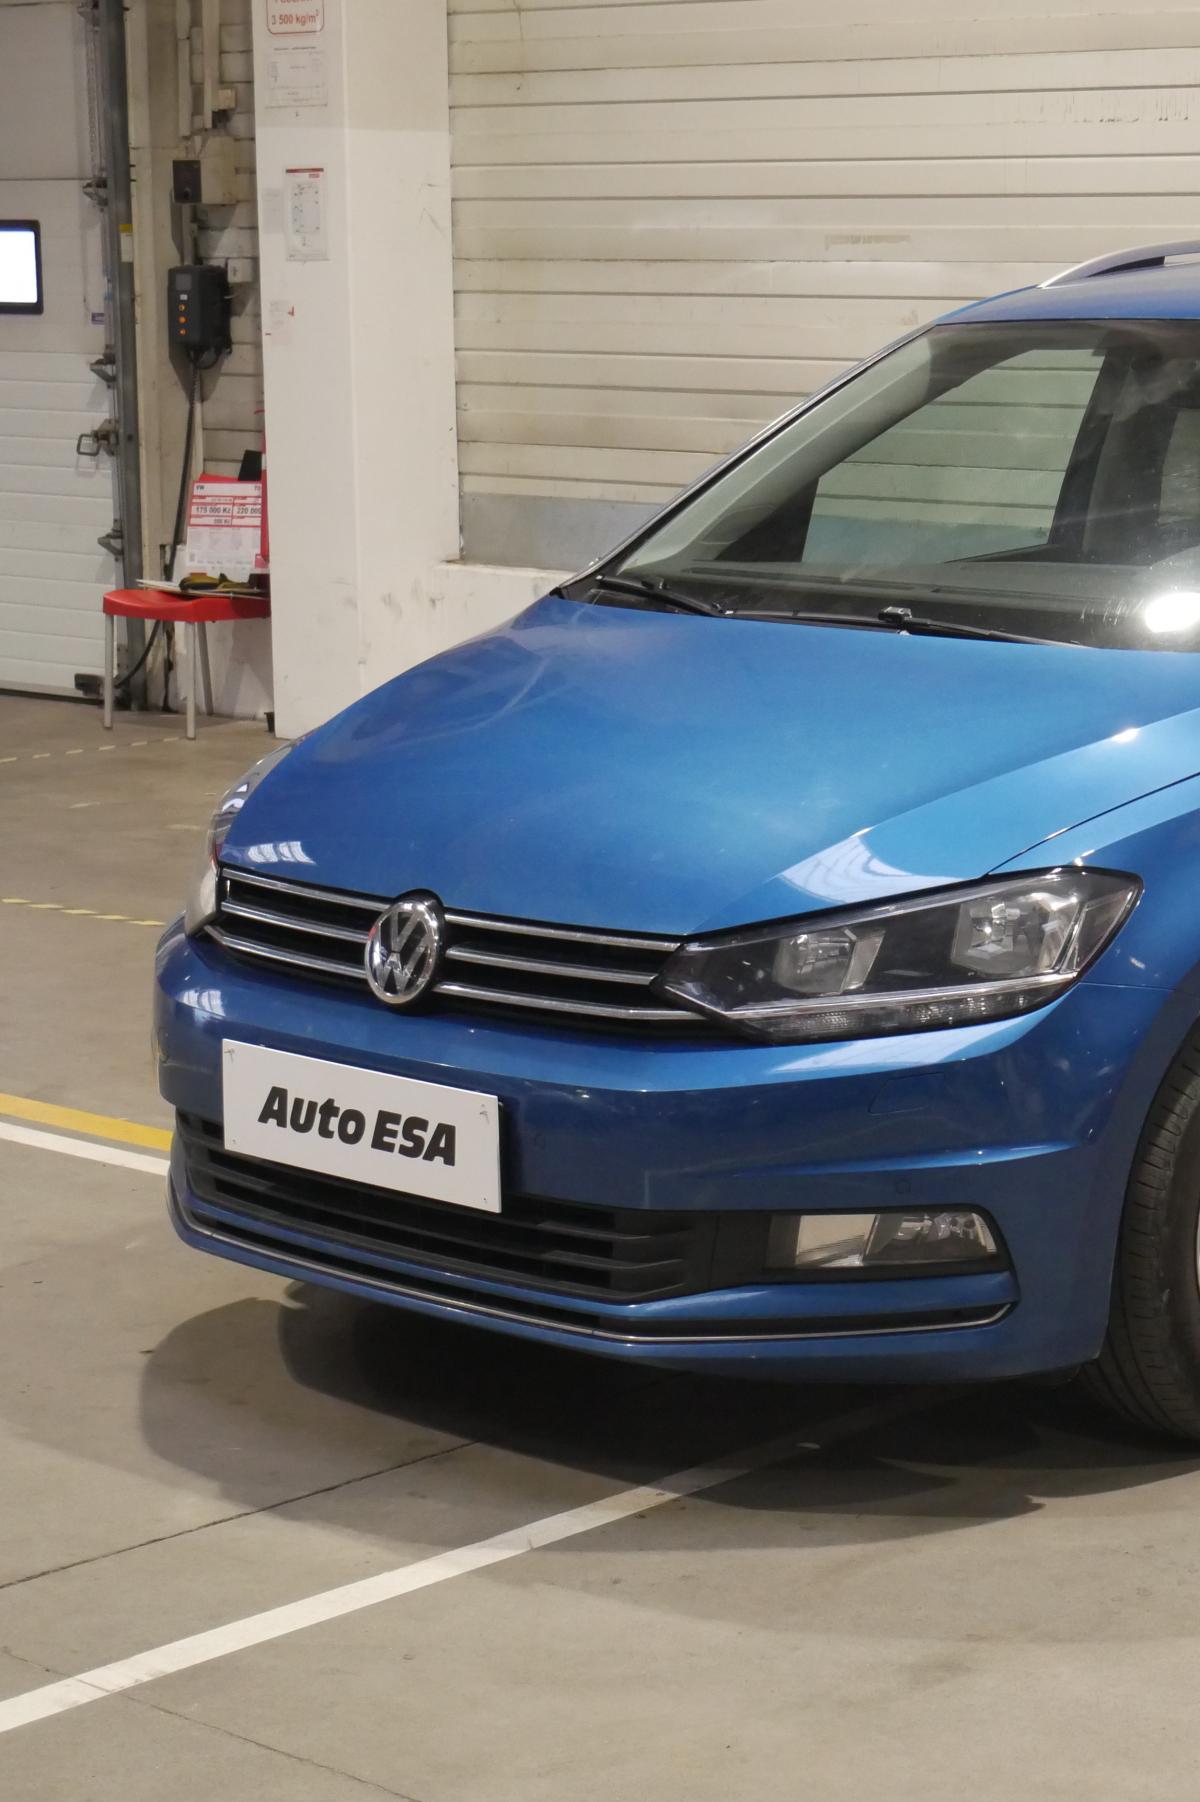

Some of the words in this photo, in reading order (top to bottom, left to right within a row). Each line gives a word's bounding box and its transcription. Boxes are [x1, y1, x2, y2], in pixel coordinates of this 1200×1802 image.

[279, 14, 294, 25] 500
[209, 506, 221, 514] 000
[257, 1085, 366, 1145] Auto
[371, 1110, 456, 1167] ESA
